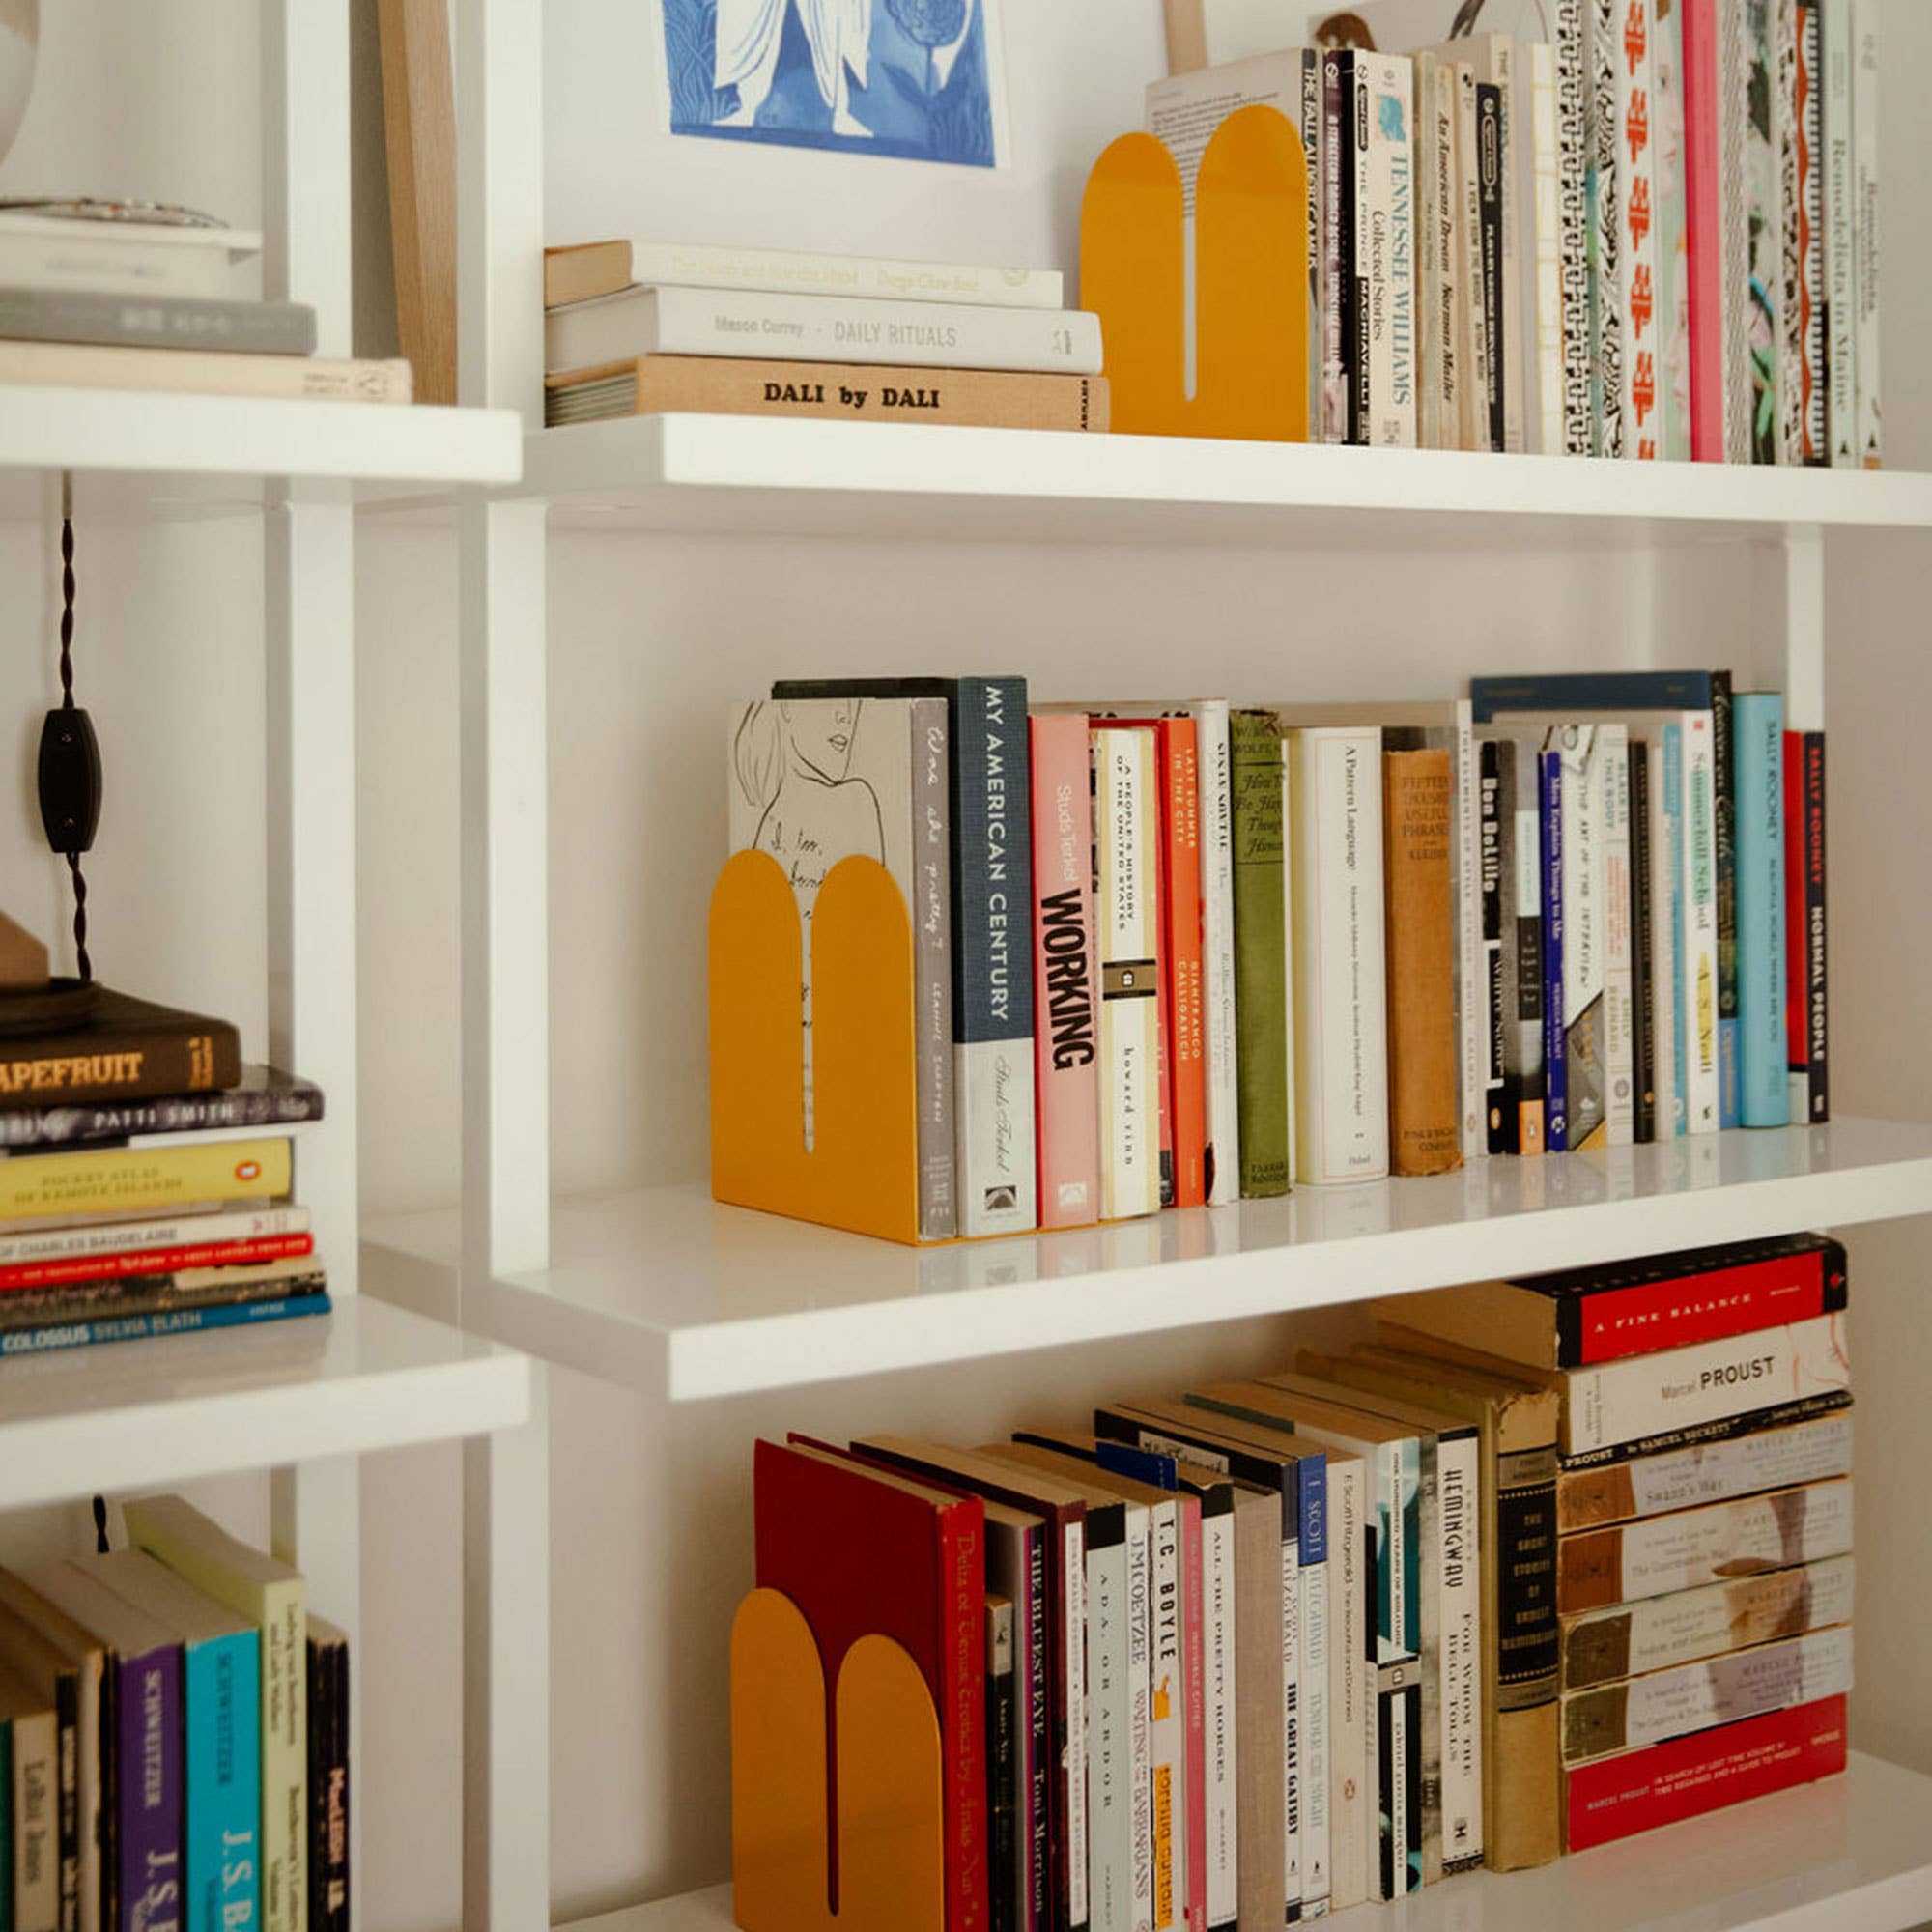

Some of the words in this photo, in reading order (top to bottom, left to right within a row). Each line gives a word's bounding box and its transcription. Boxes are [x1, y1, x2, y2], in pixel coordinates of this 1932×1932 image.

[1437, 112, 1451, 135] An
[1438, 138, 1452, 216] American
[1358, 201, 1369, 273] PRINCE
[1391, 156, 1410, 282] TENNESSEE
[1372, 210, 1387, 284] Collected
[1439, 219, 1452, 272] Dream
[834, 321, 882, 344] DAILY
[888, 324, 957, 348] RITUALS
[1373, 286, 1387, 344] Stories
[1441, 283, 1454, 347] Norman
[1359, 279, 1370, 406] MACHIAVELLI
[1391, 291, 1410, 406] WILLIAMS
[764, 383, 825, 404] DALI
[838, 386, 869, 410] by
[881, 388, 941, 409] DALI
[1442, 348, 1455, 403] Mailer
[985, 686, 1006, 724] MY
[1116, 755, 1125, 774] OF
[1174, 753, 1184, 769] IN
[1185, 747, 1196, 782] LAST
[1217, 742, 1228, 788] SUSAN
[1345, 745, 1356, 756] A
[1766, 721, 1778, 763] SALLY
[1116, 781, 1125, 809] THE
[1123, 765, 1132, 776] A
[1174, 776, 1184, 804] THE
[1344, 757, 1357, 806] Pattern
[1481, 777, 1498, 816] Don
[1549, 776, 1561, 807] Men
[1809, 747, 1822, 800] SALLY
[985, 733, 1008, 882] AMERICAN
[1055, 785, 1074, 833] Studs
[1123, 781, 1135, 852] PEOPLE'S
[1175, 809, 1185, 844] CITY
[1185, 790, 1197, 849] SUMMER
[1218, 793, 1229, 854] SONTAG
[1605, 787, 1615, 830] BODY
[1692, 752, 1709, 860] Summerhill
[1767, 768, 1779, 840] ROONEY
[1116, 813, 1126, 870] UNITED
[1344, 808, 1358, 871] Language
[1547, 808, 1561, 858] Explain
[1579, 819, 1590, 843] ART
[1810, 806, 1823, 884] ROONEY
[1057, 834, 1080, 883] Terkel
[1548, 861, 1562, 902] Things
[1580, 872, 1591, 897] THE
[1117, 874, 1127, 931] STATES
[1124, 857, 1135, 921] HISTORY
[1550, 904, 1562, 918] to
[1694, 865, 1712, 932] School
[1551, 919, 1563, 941] Me
[1579, 906, 1592, 988] INTERVIEW
[1811, 906, 1825, 986] NORMAL
[988, 893, 1010, 1022] CENTURY
[1041, 888, 1095, 1071] WORKING
[1190, 960, 1200, 1060] GIANFRANCO
[1812, 992, 1825, 1061] PEOPLE
[1698, 1027, 1713, 1074] Neill
[1122, 1046, 1135, 1115] howard
[94, 1105, 157, 1129] PATTI
[166, 1102, 234, 1125] SMITH
[18, 1237, 87, 1256] CHARLES
[89, 1228, 178, 1250] BAUDELAIRE
[2, 1323, 92, 1352] COLOSSUS
[93, 1318, 149, 1340] SYLVIA
[151, 1312, 203, 1333] PLATH
[1594, 1322, 1605, 1333] A
[1615, 1312, 1660, 1329] FINE
[1669, 1293, 1752, 1318] BALANCE
[1699, 1355, 1776, 1390] PROUST
[1565, 1448, 1614, 1468] PROUST
[1343, 1485, 1354, 1520] Scott
[1443, 1467, 1464, 1589] HEMINGWAY
[1031, 1543, 1044, 1593] THE
[1213, 1531, 1223, 1566] ALL
[1342, 1520, 1354, 1584] Fitzgerald
[1099, 1574, 1111, 1639] ADA,
[1158, 1581, 1177, 1662] BOYLE
[1214, 1577, 1223, 1615] THE
[1031, 1596, 1044, 1684] BLUEST
[1214, 1621, 1224, 1694] PRETTY
[1461, 1612, 1473, 1653] FOR
[1100, 1654, 1111, 1690] OR
[1447, 1633, 1460, 1690] BELL
[1032, 1689, 1045, 1739] EYE
[1286, 1681, 1298, 1712] THE
[1462, 1662, 1473, 1725] WHOM
[143, 1668, 163, 1808] SCHWEITZER
[1215, 1704, 1225, 1784] HORSES
[1286, 1717, 1298, 1769] GREAT
[1447, 1698, 1460, 1762] TOLLS
[1101, 1708, 1112, 1808] ARDOR
[1462, 1736, 1473, 1777] THE
[1033, 1768, 1046, 1816] Toni
[1287, 1774, 1299, 1835] GATSBY
[1033, 1821, 1047, 1913] Morrison
